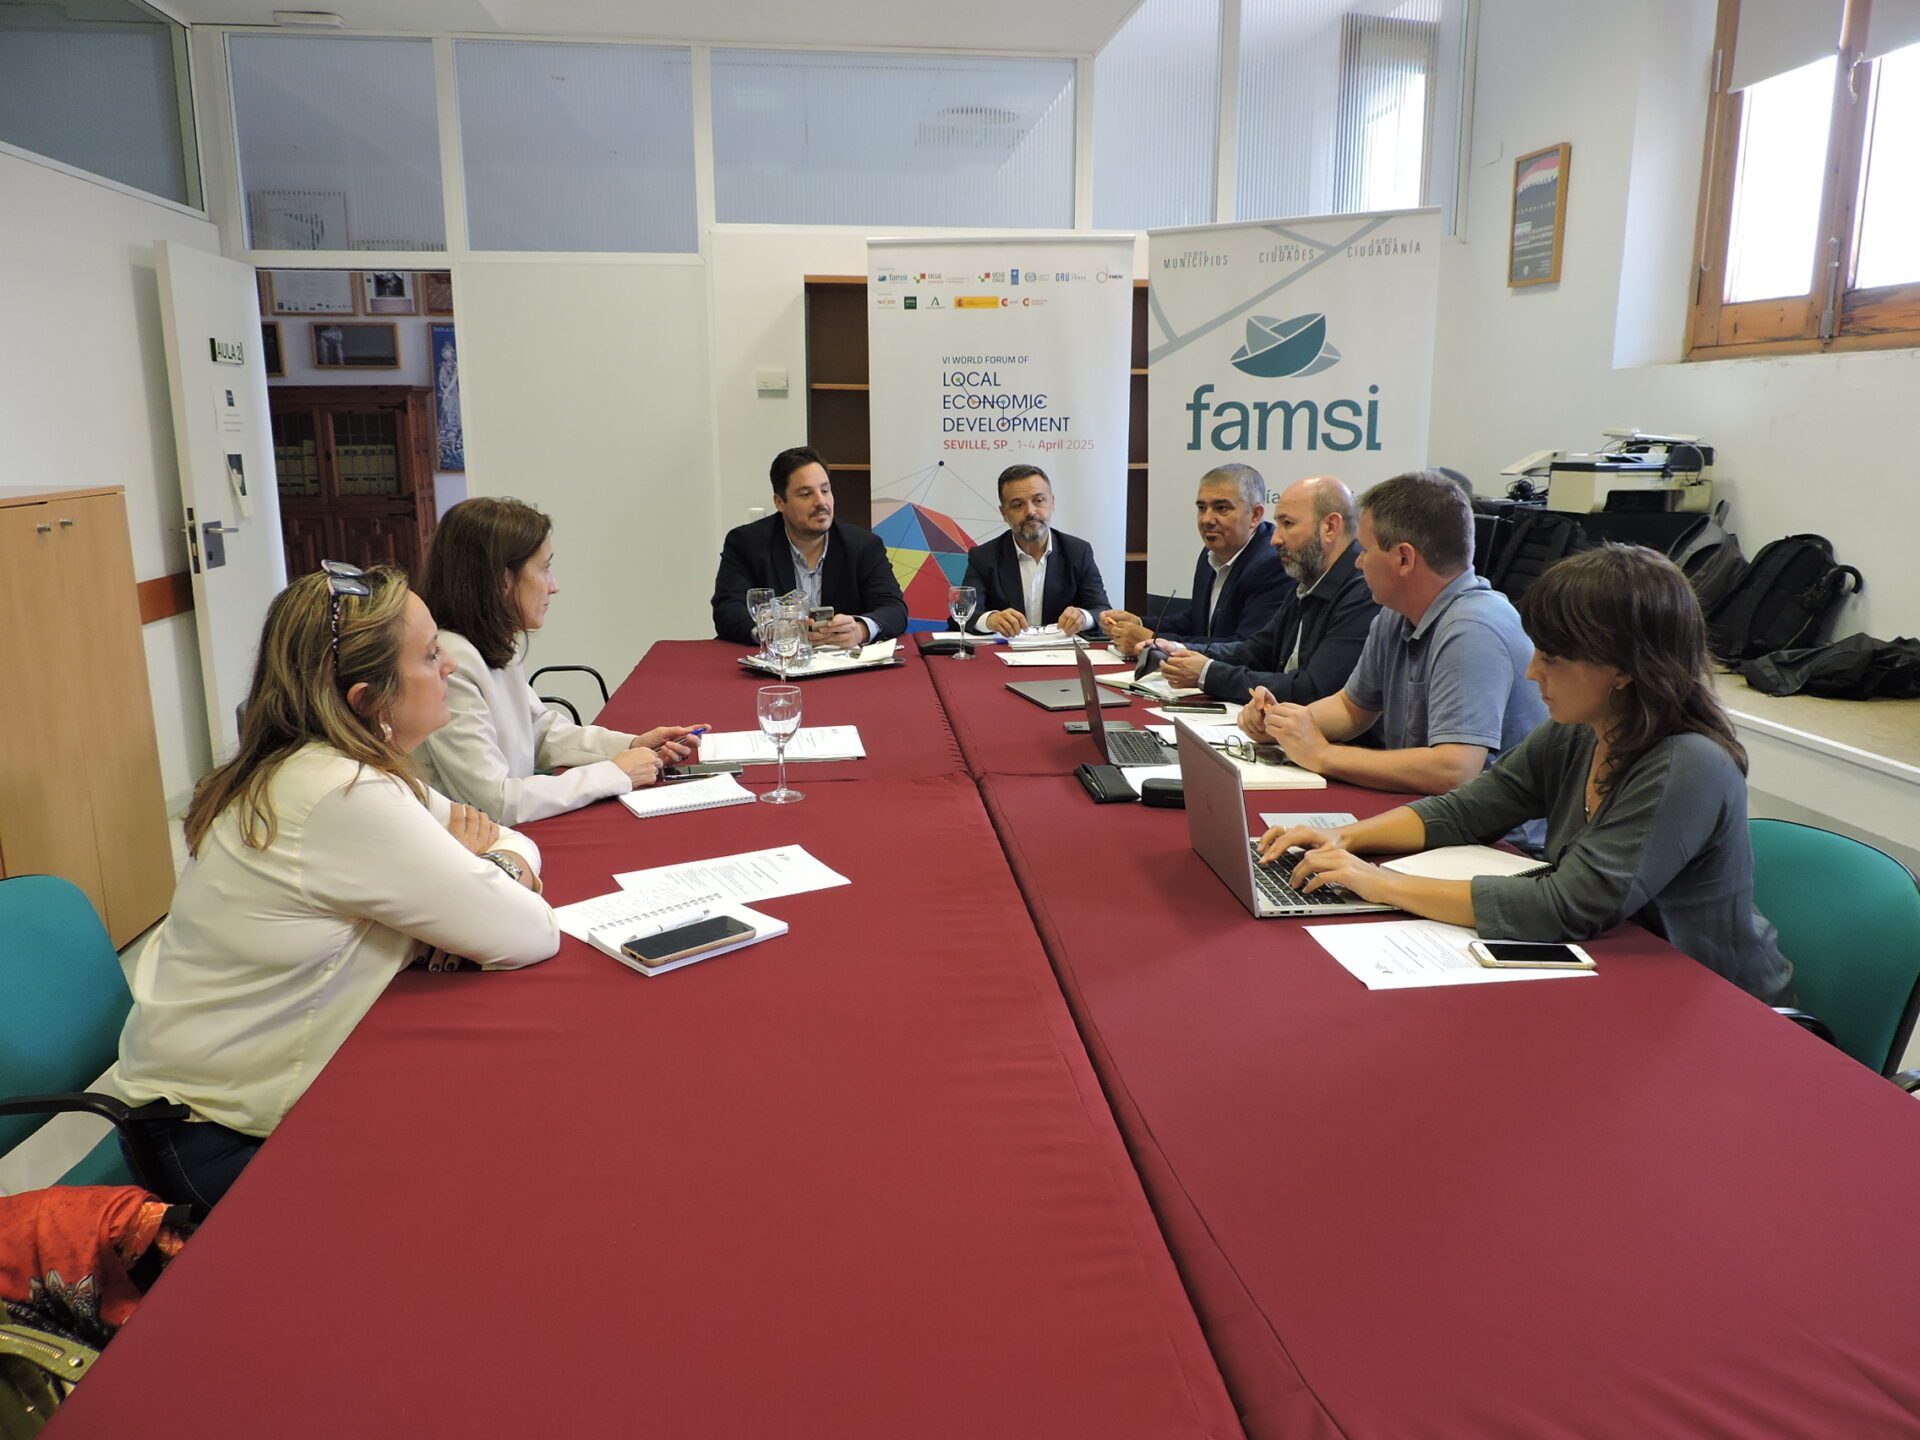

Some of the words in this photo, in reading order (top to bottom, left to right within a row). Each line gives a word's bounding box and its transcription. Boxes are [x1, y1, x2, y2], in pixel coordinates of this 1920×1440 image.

[1347, 239, 1421, 257] CIUDADANÍA
[1163, 254, 1228, 269] MUNICIPIOS
[1259, 249, 1314, 263] CIUDADES
[216, 341, 236, 361] AULA
[236, 343, 242, 361] 2
[942, 356, 951, 364] VI
[952, 356, 983, 364] WORLD
[985, 356, 1016, 364] FORUM
[1018, 356, 1029, 364] OF
[943, 371, 1001, 387] LOCAL
[942, 394, 1048, 409] ECONOMIC
[942, 417, 1070, 432] DEVELOPMENT
[1186, 384, 1382, 451] famsi
[943, 439, 990, 451] SEVILLE,
[1017, 439, 1036, 449] 1-4
[1038, 438, 1064, 452] April
[1066, 439, 1095, 450] 2025
